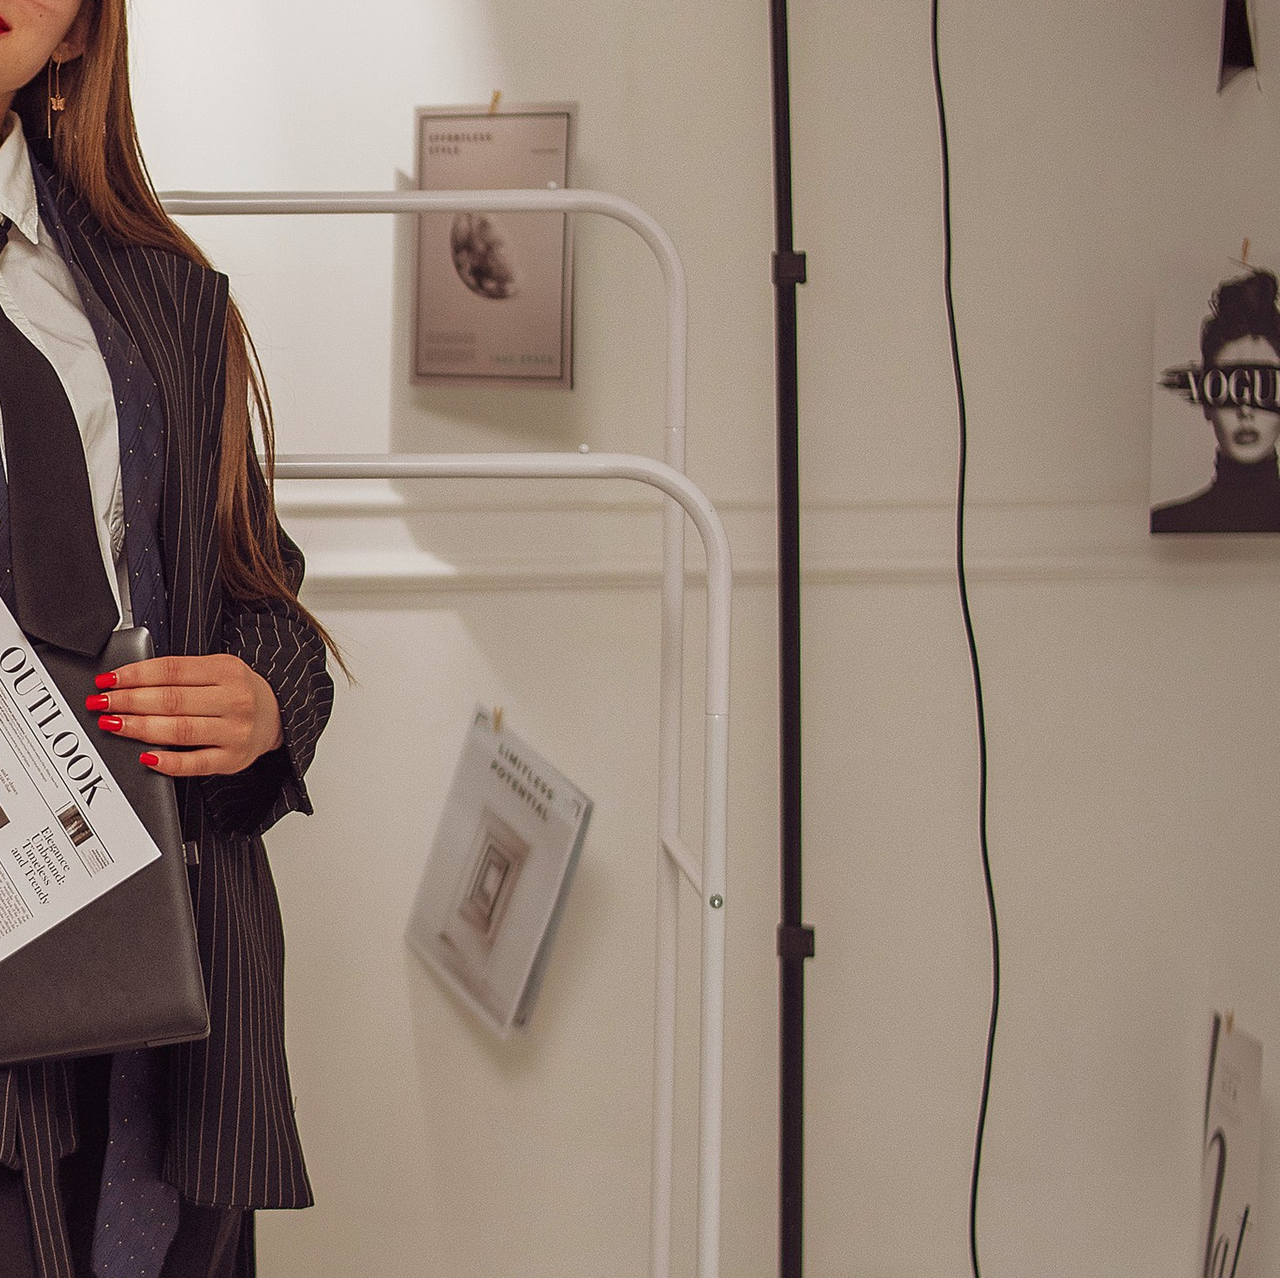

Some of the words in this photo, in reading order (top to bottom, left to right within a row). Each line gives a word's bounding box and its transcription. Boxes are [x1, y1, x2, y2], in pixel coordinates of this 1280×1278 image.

[1186, 368, 1280, 407] VOGU
[0, 767, 9, 778] and
[491, 758, 548, 822] POTENTIAL
[498, 742, 554, 802] LIMITLESS
[20, 837, 52, 888] Timeless
[30, 832, 66, 886] Unbound:
[40, 825, 72, 873] Elegance
[11, 847, 31, 873] and
[24, 869, 51, 907] Trendy
